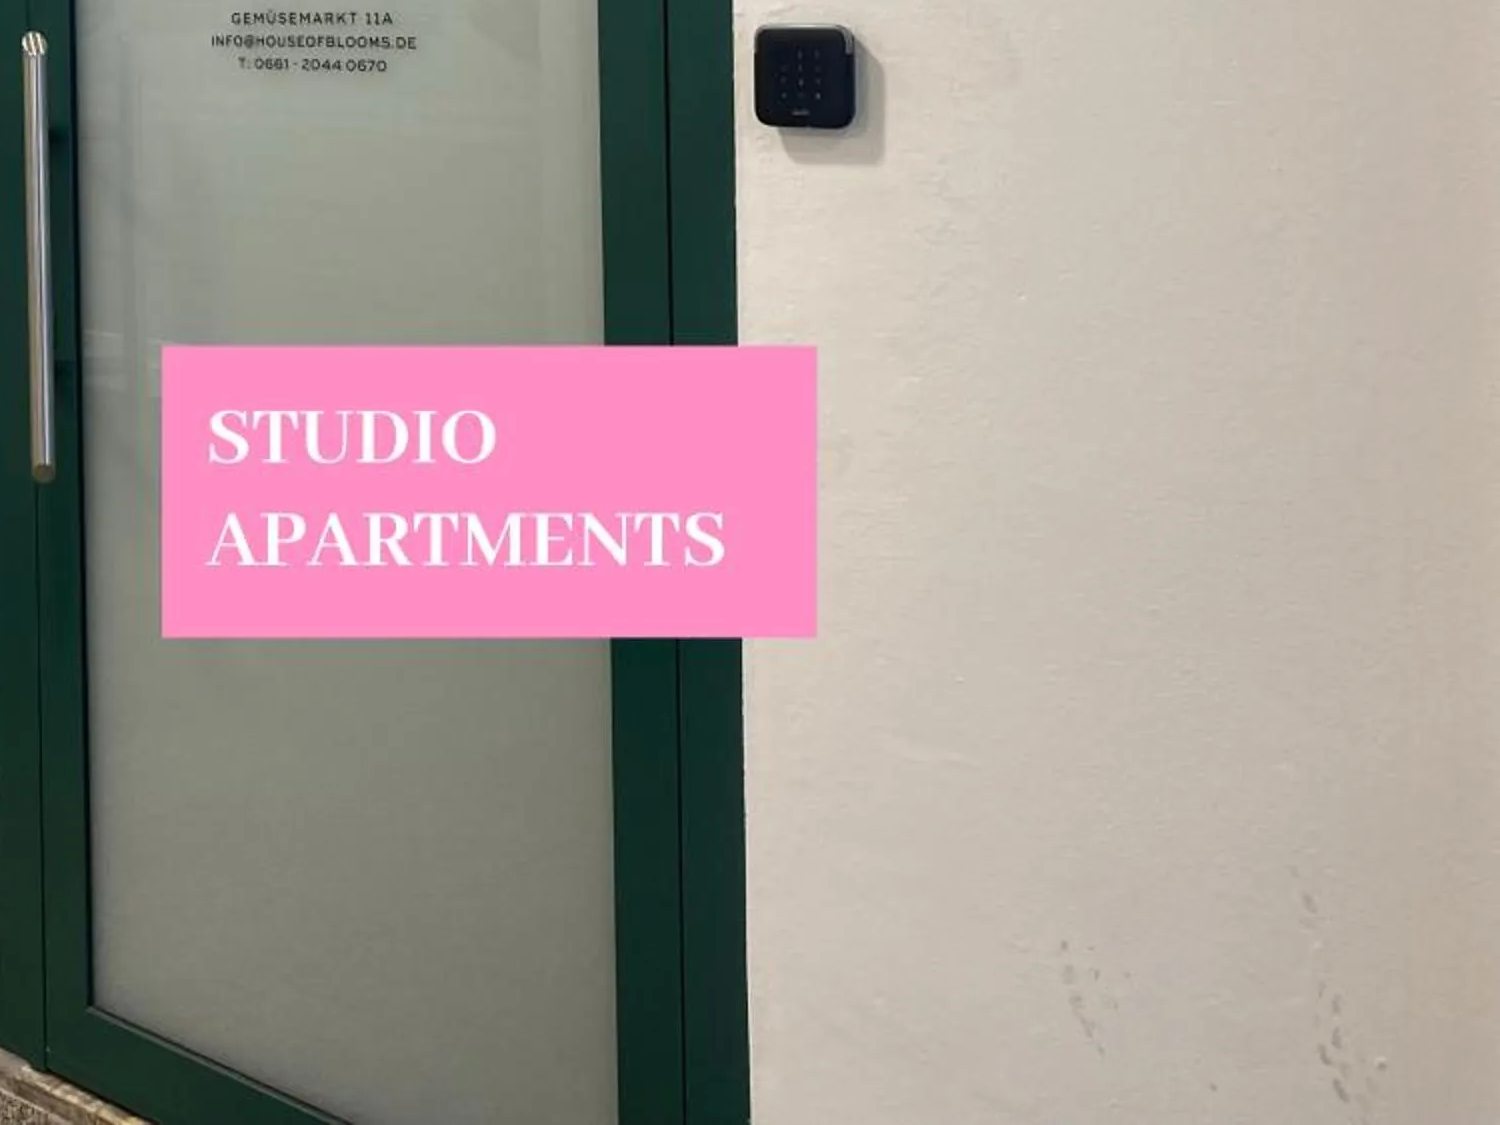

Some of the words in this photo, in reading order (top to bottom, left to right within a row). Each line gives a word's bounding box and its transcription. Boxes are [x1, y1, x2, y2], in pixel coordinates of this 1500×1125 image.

[231, 9, 357, 25] GEMÜSEMARKT
[365, 12, 393, 25] 11A
[211, 35, 417, 50] INFO@HOUSEOFBLOOMS.DE
[301, 58, 342, 72] 2044
[345, 59, 388, 72] 0670
